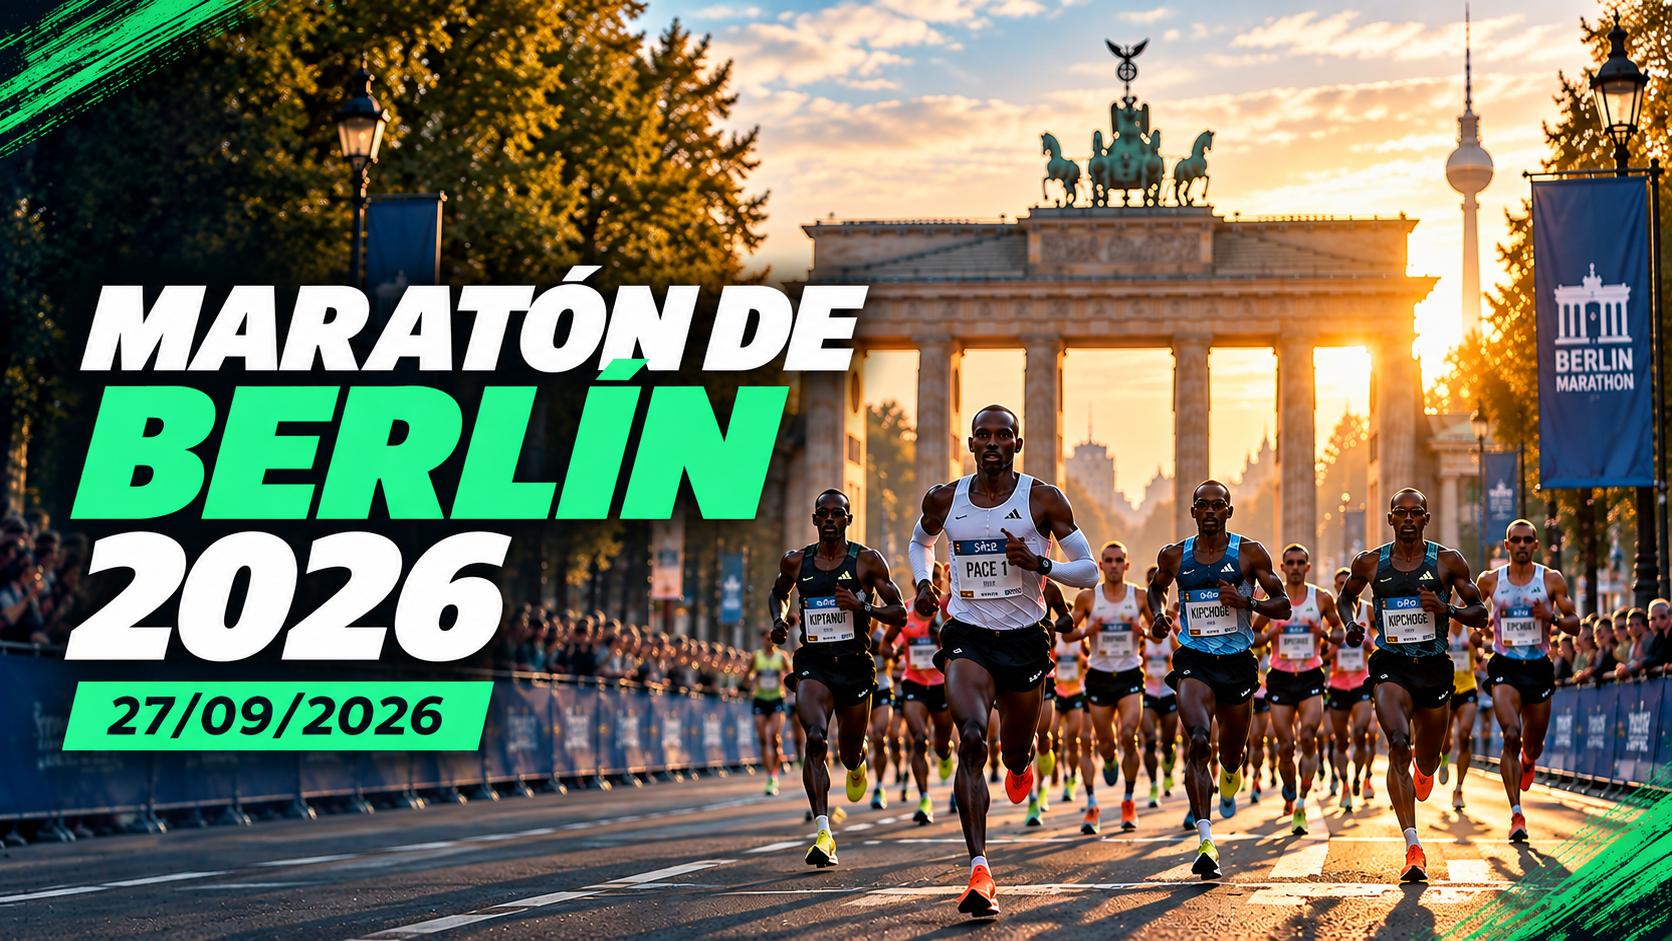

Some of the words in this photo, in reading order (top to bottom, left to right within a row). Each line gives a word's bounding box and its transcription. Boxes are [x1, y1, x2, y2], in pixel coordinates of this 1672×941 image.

[1555, 347, 1633, 373] BERLIN
[1556, 373, 1634, 392] MARATHON
[966, 561, 997, 578] PACE
[1001, 560, 1007, 576] 1
[1388, 612, 1429, 627] KIPCHOGE
